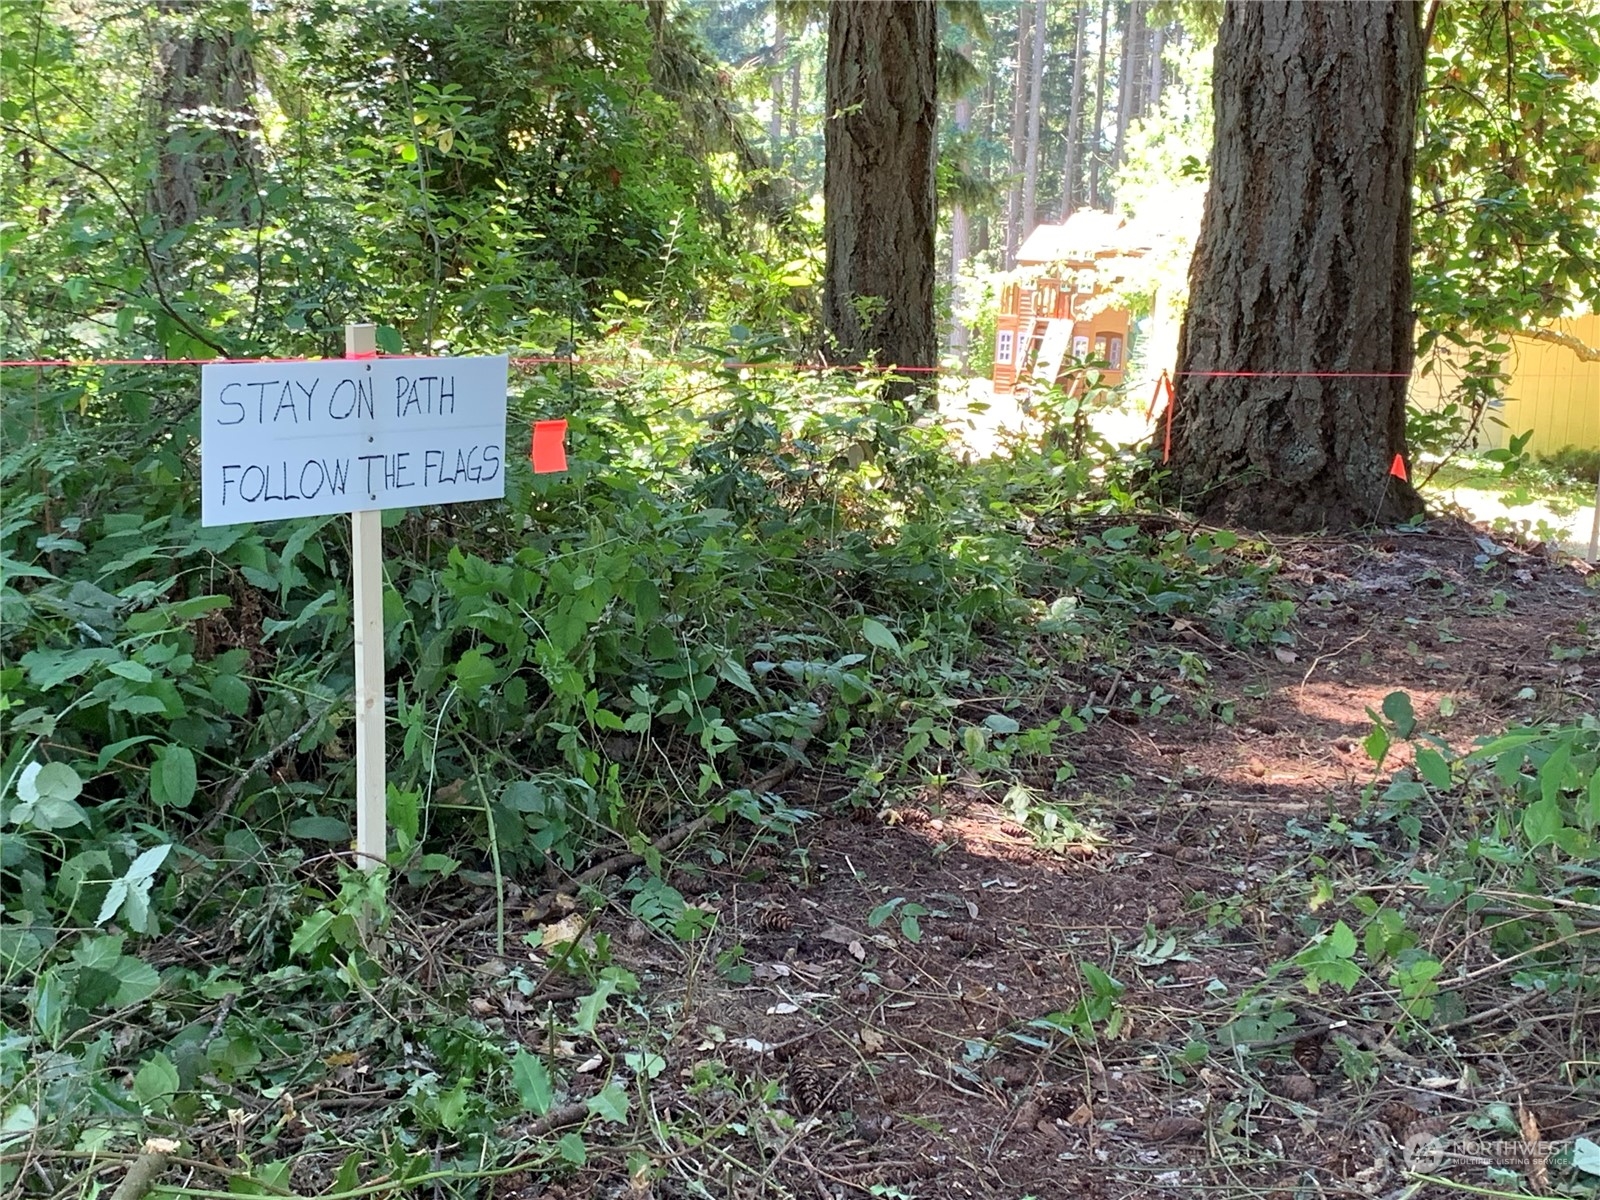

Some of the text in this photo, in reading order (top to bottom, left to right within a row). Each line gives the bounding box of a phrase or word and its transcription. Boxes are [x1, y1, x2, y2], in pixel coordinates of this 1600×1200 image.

[217, 375, 455, 425] STAY ON PATH
[222, 445, 500, 506] FOLLOW THE FLAGS
